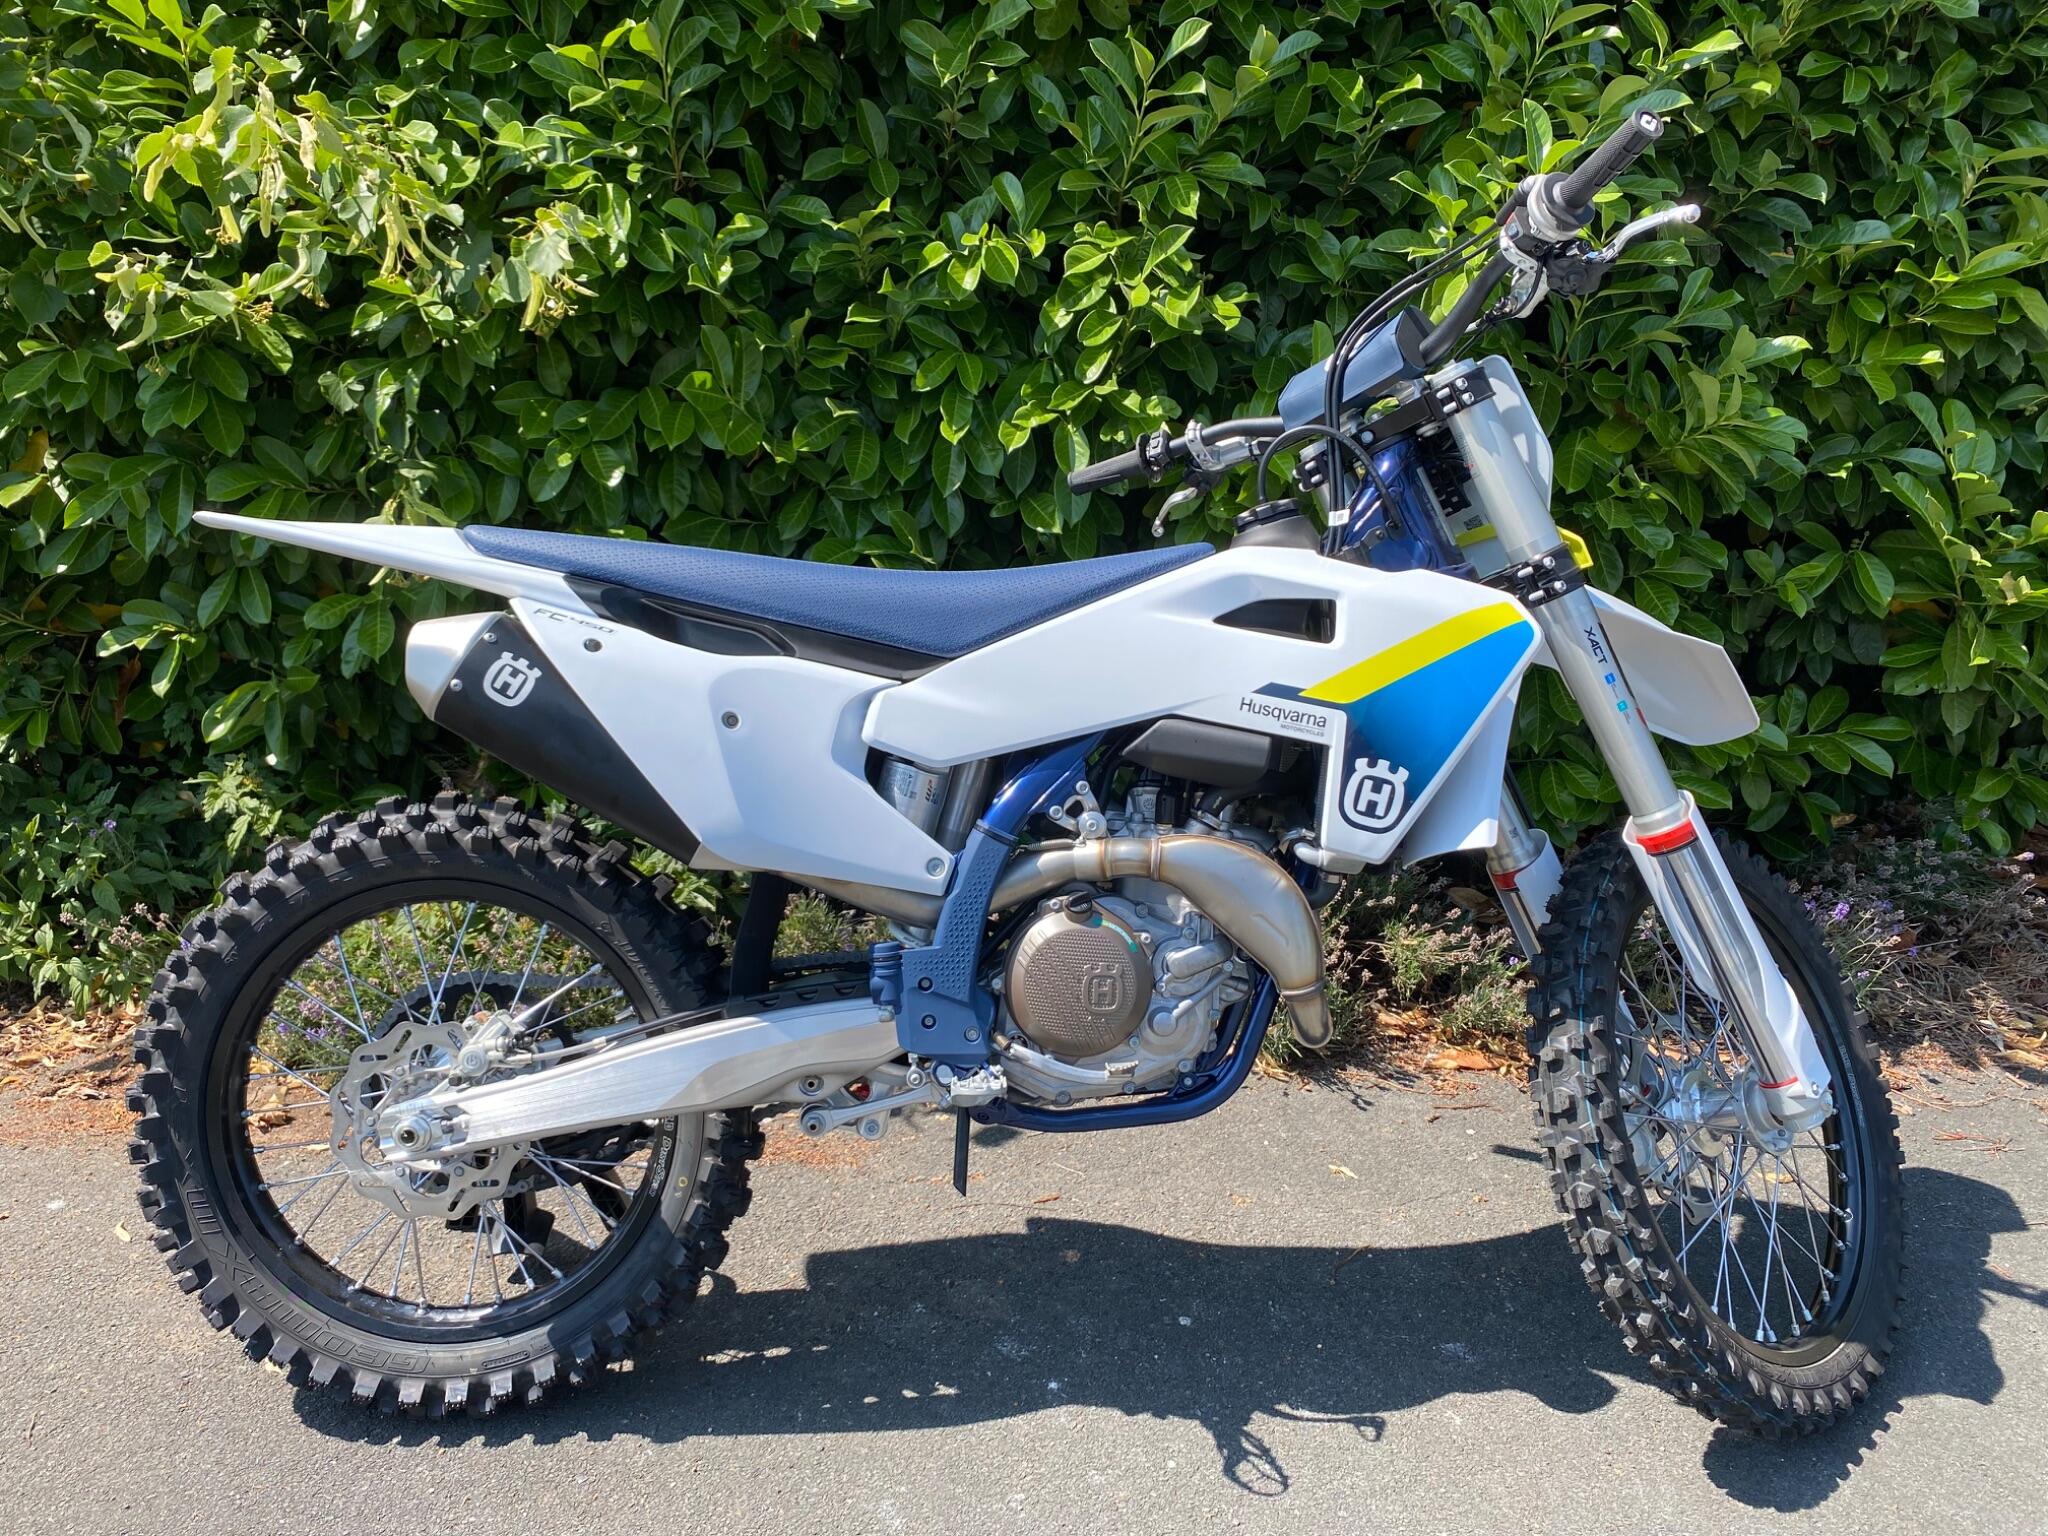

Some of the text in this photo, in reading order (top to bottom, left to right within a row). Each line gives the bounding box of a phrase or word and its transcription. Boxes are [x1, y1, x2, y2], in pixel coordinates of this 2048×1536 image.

[533, 608, 568, 622] FC
[1583, 626, 1608, 664] XACT
[1239, 696, 1328, 729] Husqvarna
[1280, 723, 1326, 738] MOTORCYCLES
[208, 1242, 432, 1376] GEOMAX
